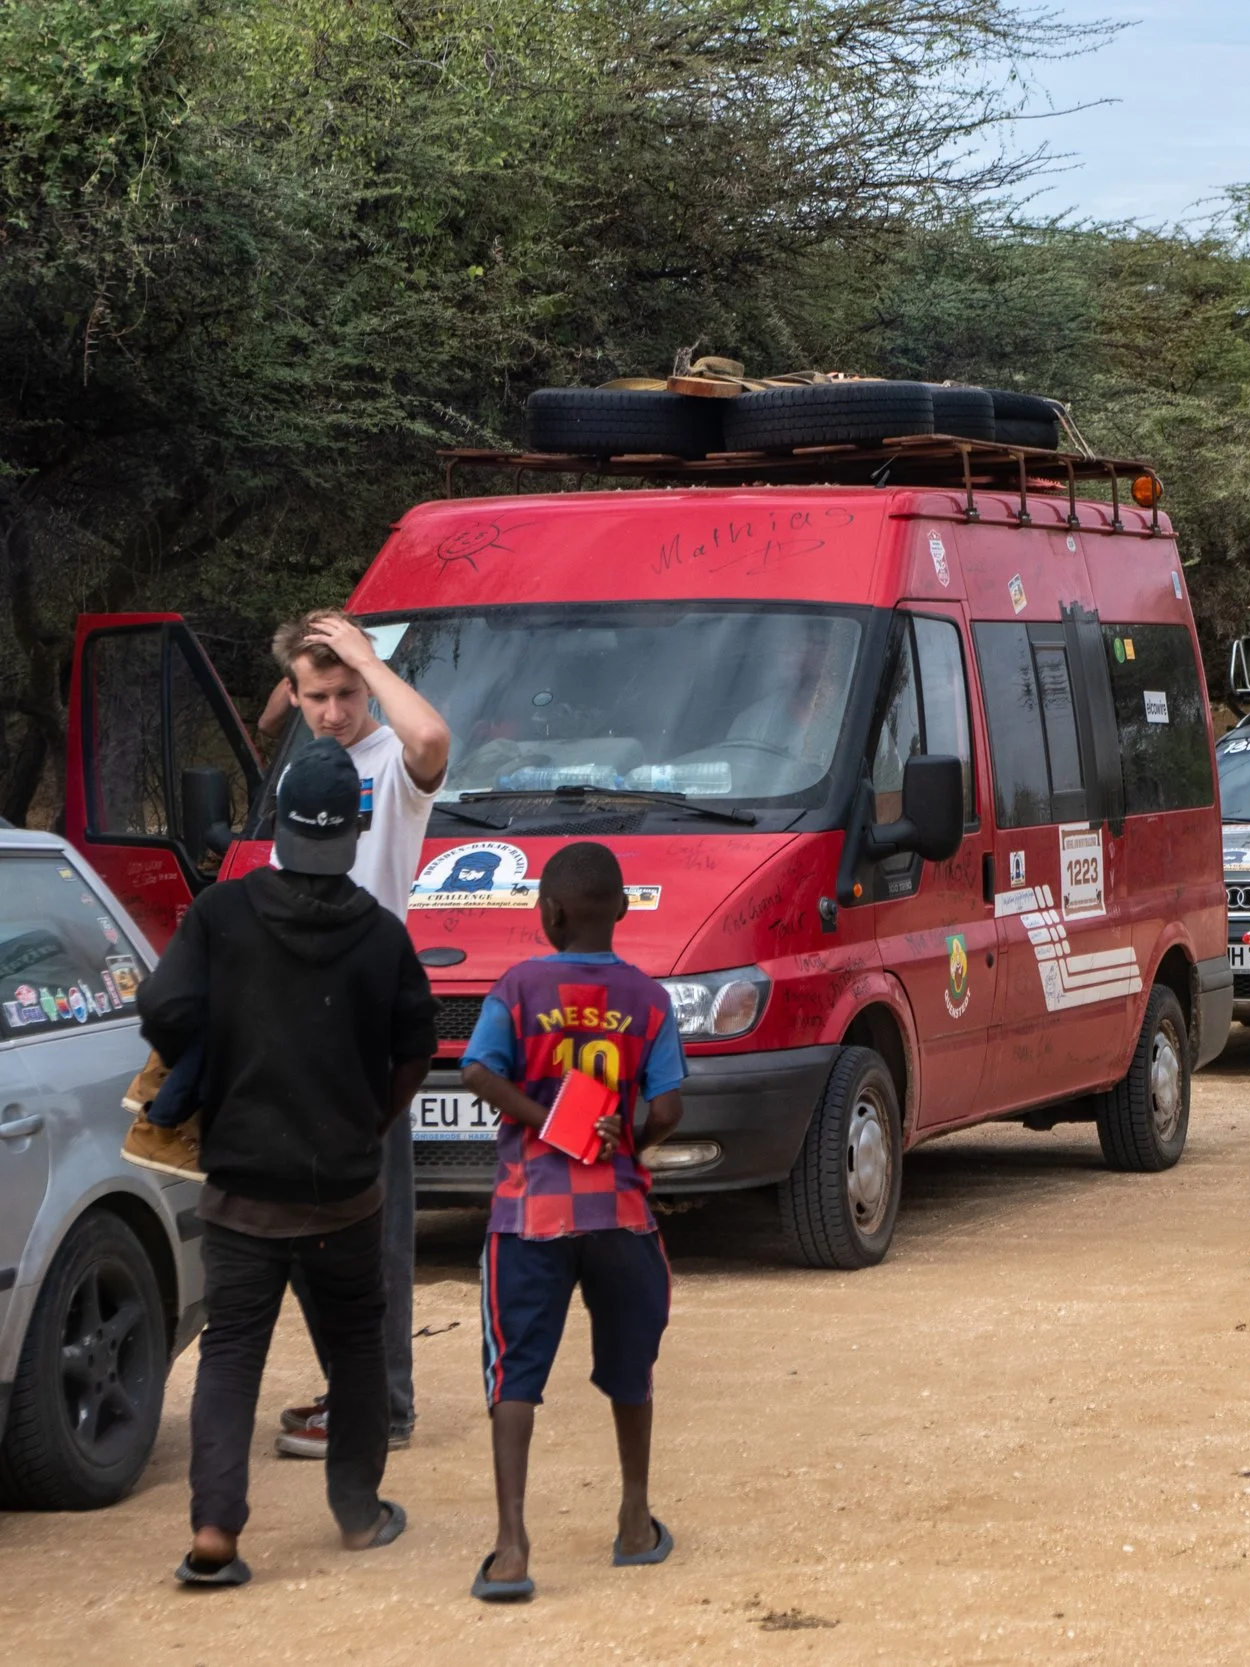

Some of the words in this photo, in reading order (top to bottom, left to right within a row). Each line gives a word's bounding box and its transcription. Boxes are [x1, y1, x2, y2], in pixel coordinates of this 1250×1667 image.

[1066, 857, 1099, 887] 1223
[427, 893, 493, 901] CHALLENGE
[536, 1006, 633, 1034] MESSI
[552, 1037, 620, 1092] 10
[420, 1097, 459, 1128] EU
